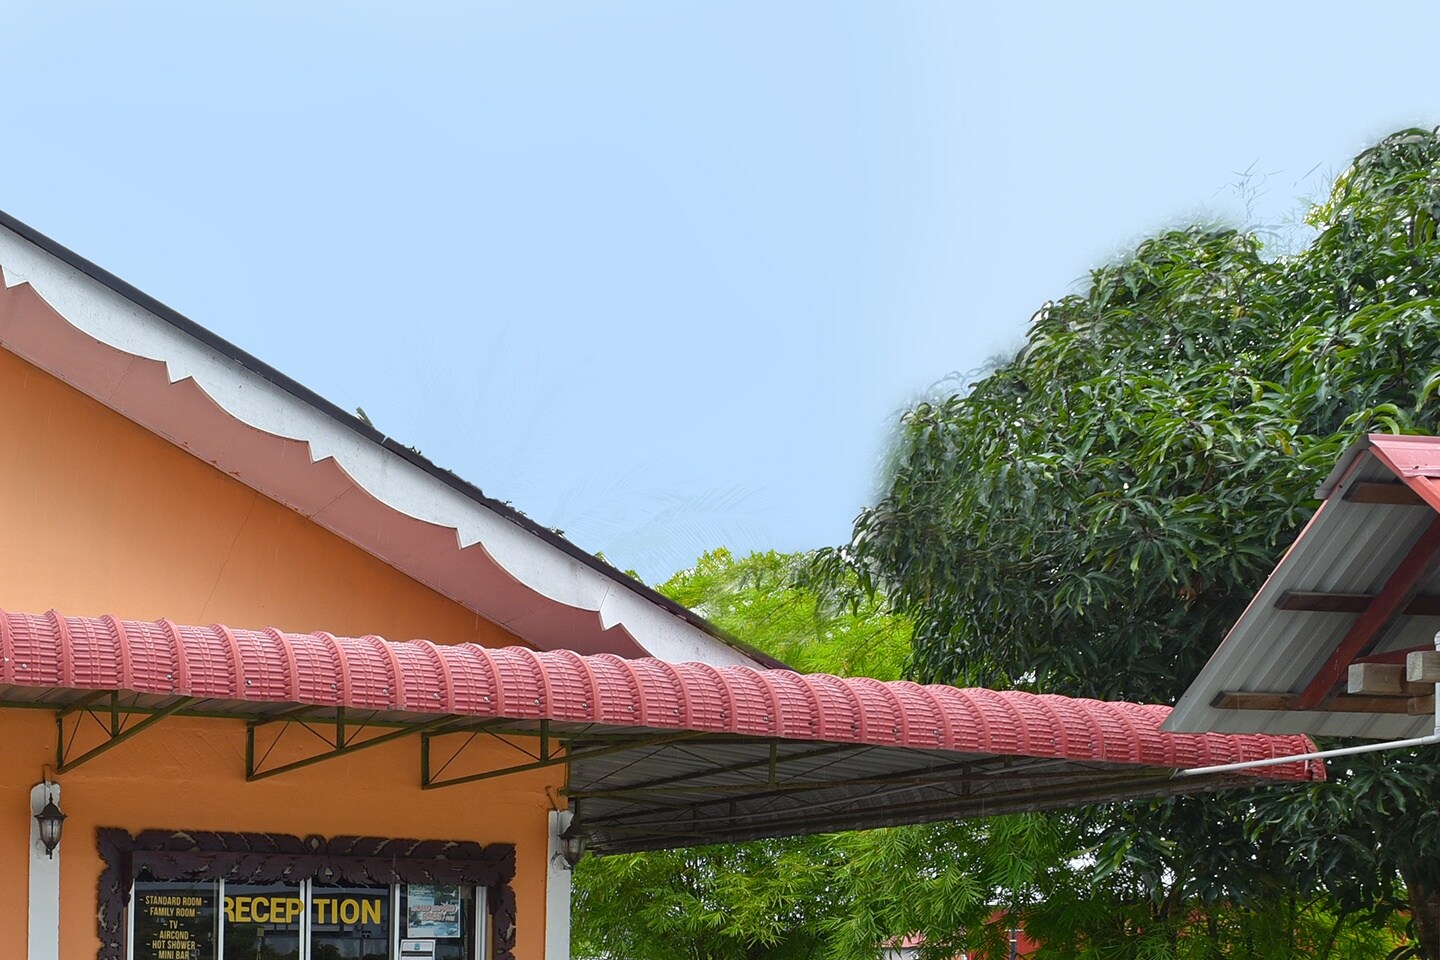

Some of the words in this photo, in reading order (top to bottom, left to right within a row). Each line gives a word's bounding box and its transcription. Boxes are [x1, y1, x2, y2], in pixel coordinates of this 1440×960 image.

[145, 895, 181, 905] STANDARD
[182, 897, 202, 906] ROOM
[150, 907, 175, 916] FAMILY
[176, 908, 195, 917] ROOM
[169, 920, 178, 929] TV
[159, 930, 189, 940] AIRCOND
[152, 940, 165, 949] HOT
[167, 940, 196, 949] SHOWER
[158, 950, 174, 959] MINI
[176, 951, 189, 959] BAR
